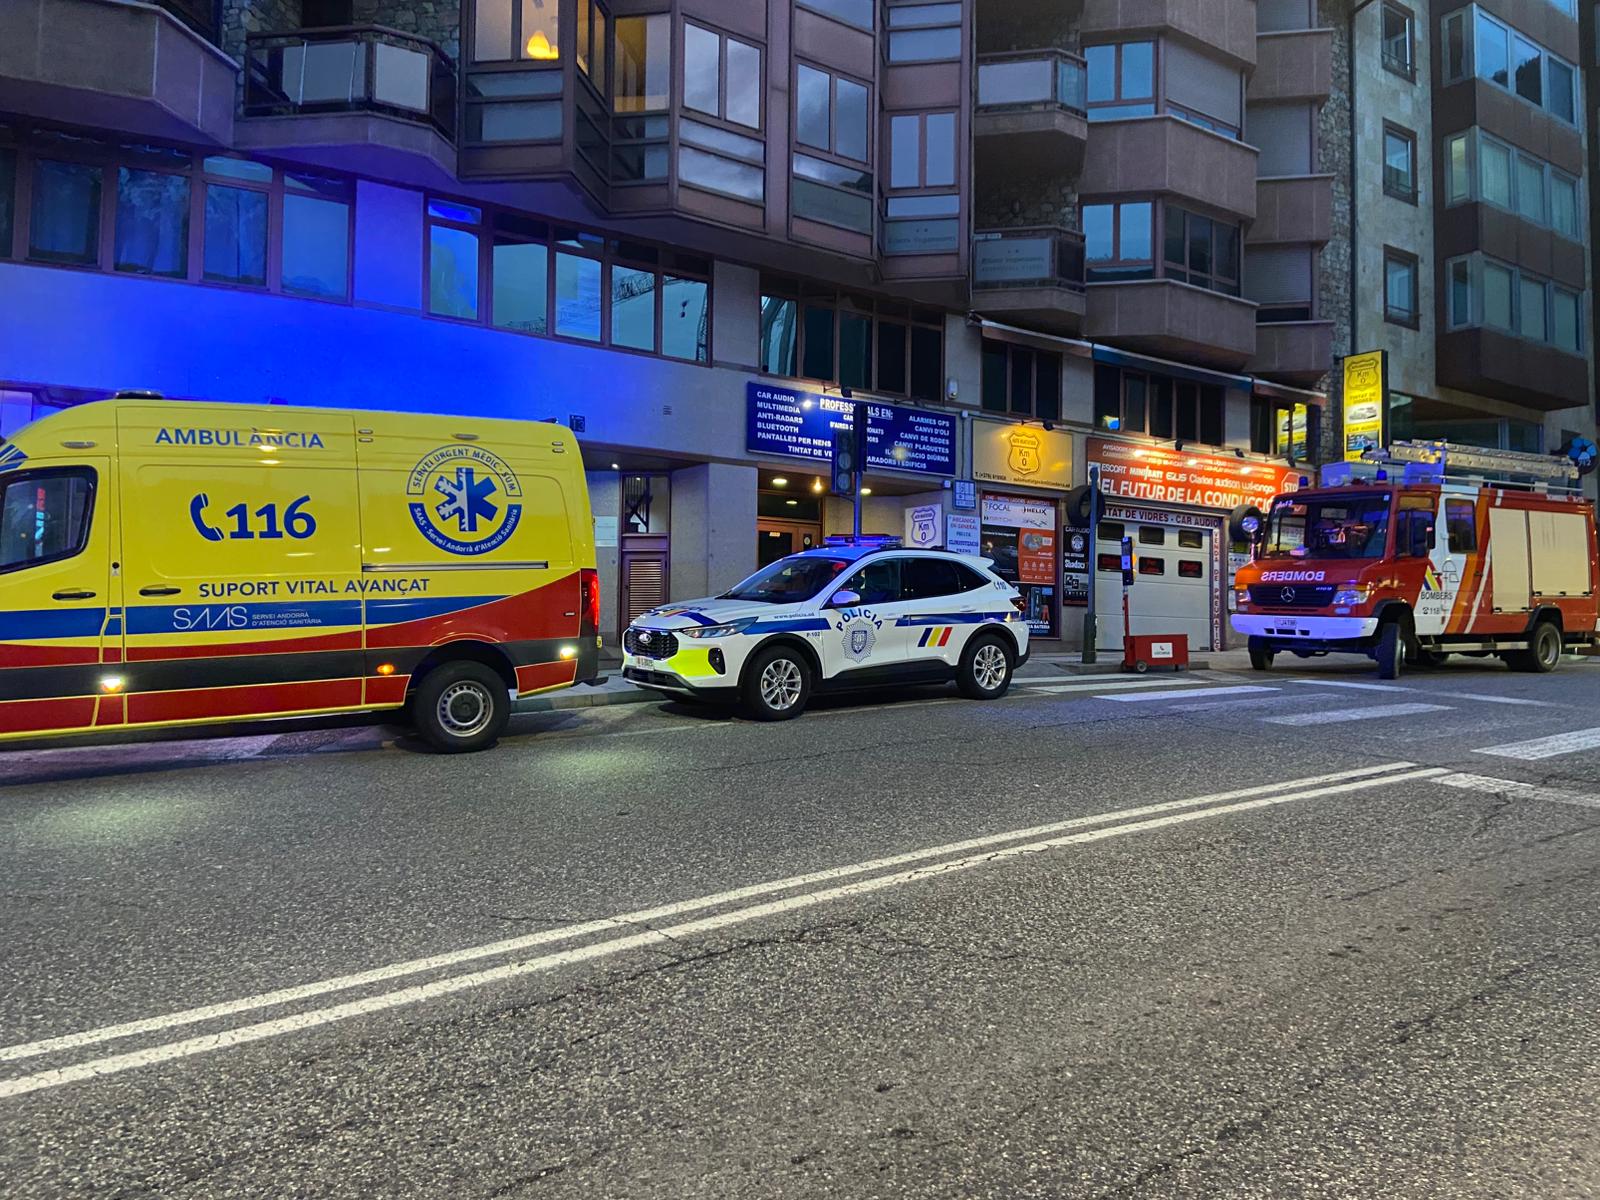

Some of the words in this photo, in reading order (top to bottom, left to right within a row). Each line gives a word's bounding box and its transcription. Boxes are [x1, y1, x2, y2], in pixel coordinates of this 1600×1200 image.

[757, 391, 772, 399] CAR
[773, 395, 795, 403] AUDIO
[757, 401, 800, 414] MULTIMEDIA
[757, 412, 803, 424] ANTI-RADARS
[908, 415, 936, 425] ALARMES
[757, 422, 799, 433] BLUETOOTH
[914, 425, 934, 434] CANVI
[934, 428, 950, 436] D'OLI
[155, 427, 324, 448] AMBULÀNCIA
[757, 432, 797, 443] PANTALLES
[813, 439, 832, 447] NENS
[900, 432, 919, 440] CANVI
[930, 436, 950, 445] RODES
[788, 445, 811, 454] TINTAT
[915, 444, 949, 454] PLAQUETES
[1019, 449, 1030, 458] Km
[901, 460, 927, 469] EDIFICIS
[1021, 458, 1027, 466] 0
[413, 461, 434, 488] SERVEI
[434, 448, 469, 461] URGENT
[501, 472, 516, 491] SUM
[1101, 463, 1127, 474] ESCORT
[1189, 474, 1213, 485] Clarion
[1215, 478, 1240, 489] audison
[1101, 478, 1117, 494] EL
[1120, 480, 1166, 500] FUTUR
[1167, 486, 1185, 503] DE
[1186, 488, 1203, 505] LA
[1284, 482, 1298, 493] STO
[989, 502, 1010, 512] FOCAL
[1027, 507, 1047, 515] HELIX
[226, 495, 317, 539] 116
[1125, 510, 1136, 518] DE
[1139, 511, 1169, 523] VIDRES
[1176, 514, 1192, 524] CAR
[1194, 518, 1219, 527] AUDIO
[919, 522, 930, 531] Km
[427, 528, 445, 546] Servei
[446, 542, 473, 552] Andorrà
[921, 532, 926, 540] 0
[199, 581, 280, 597] SUPORT
[286, 580, 338, 594] VITAL
[345, 578, 430, 596] AVANÇAT
[1421, 591, 1453, 600] BOMBERS
[836, 608, 883, 632] POLICIA
